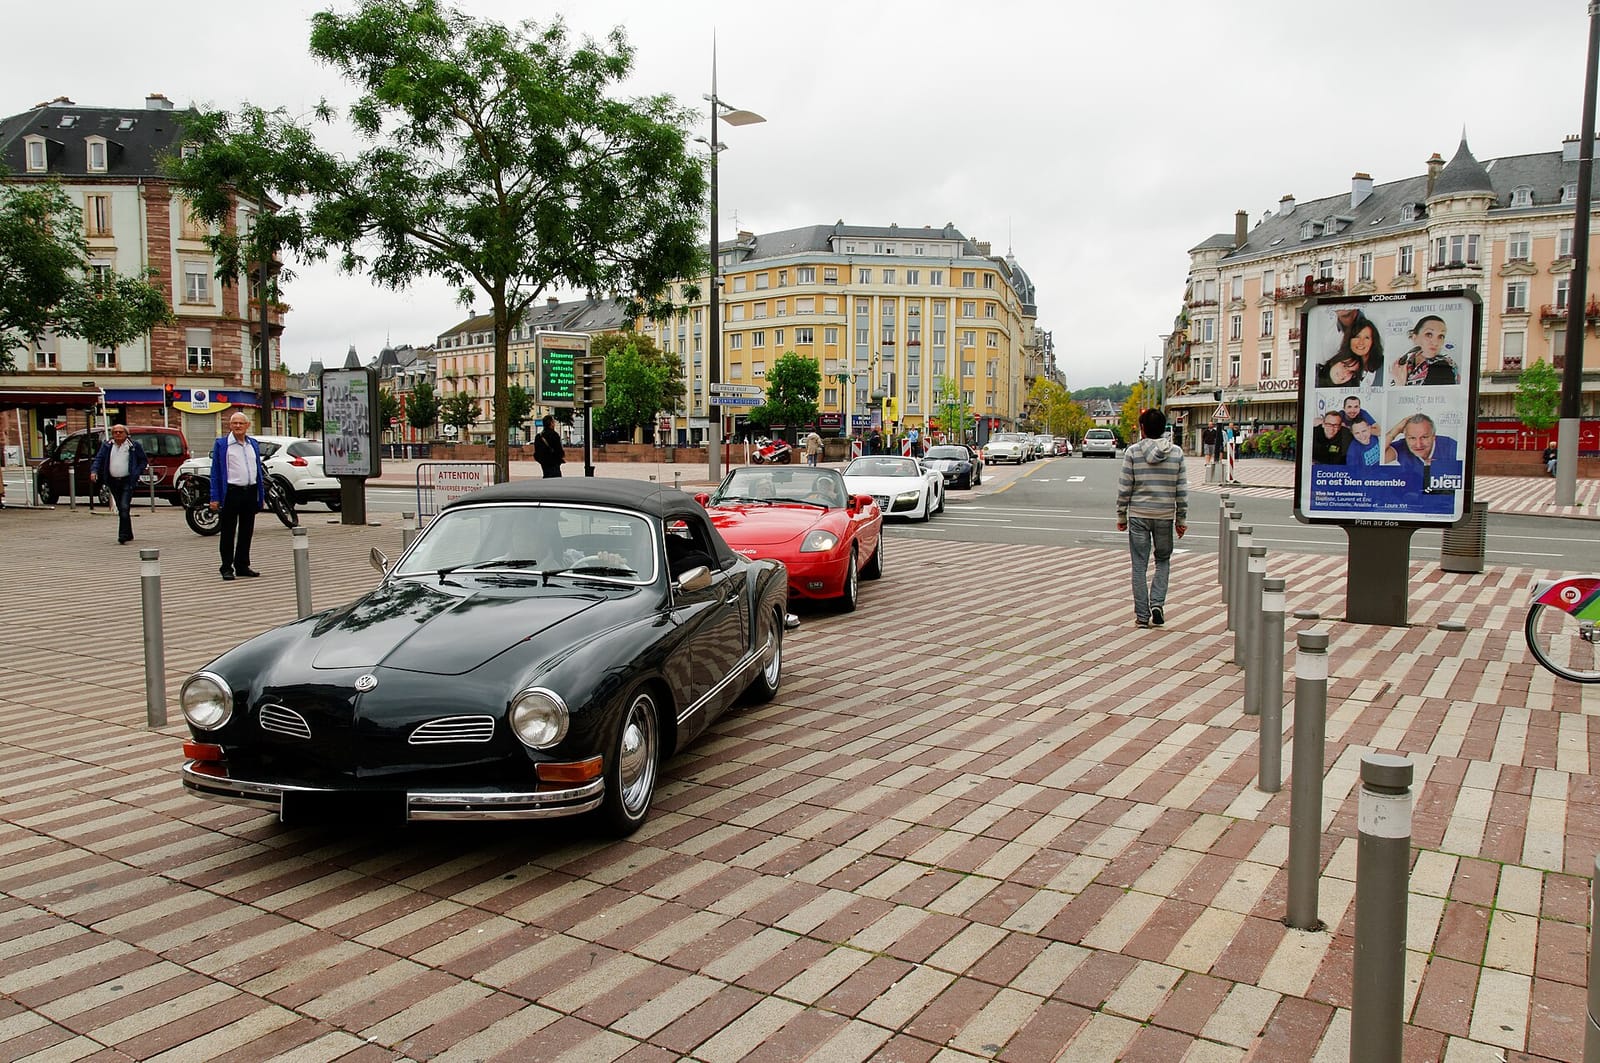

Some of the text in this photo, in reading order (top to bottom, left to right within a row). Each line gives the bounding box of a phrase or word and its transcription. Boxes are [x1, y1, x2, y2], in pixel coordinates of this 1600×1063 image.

[1369, 294, 1407, 302] JCDecaux
[438, 471, 480, 480] ATTENTION
[1344, 478, 1362, 486] bien
[1364, 479, 1406, 487] ensemble
[1430, 476, 1461, 488] bleu
